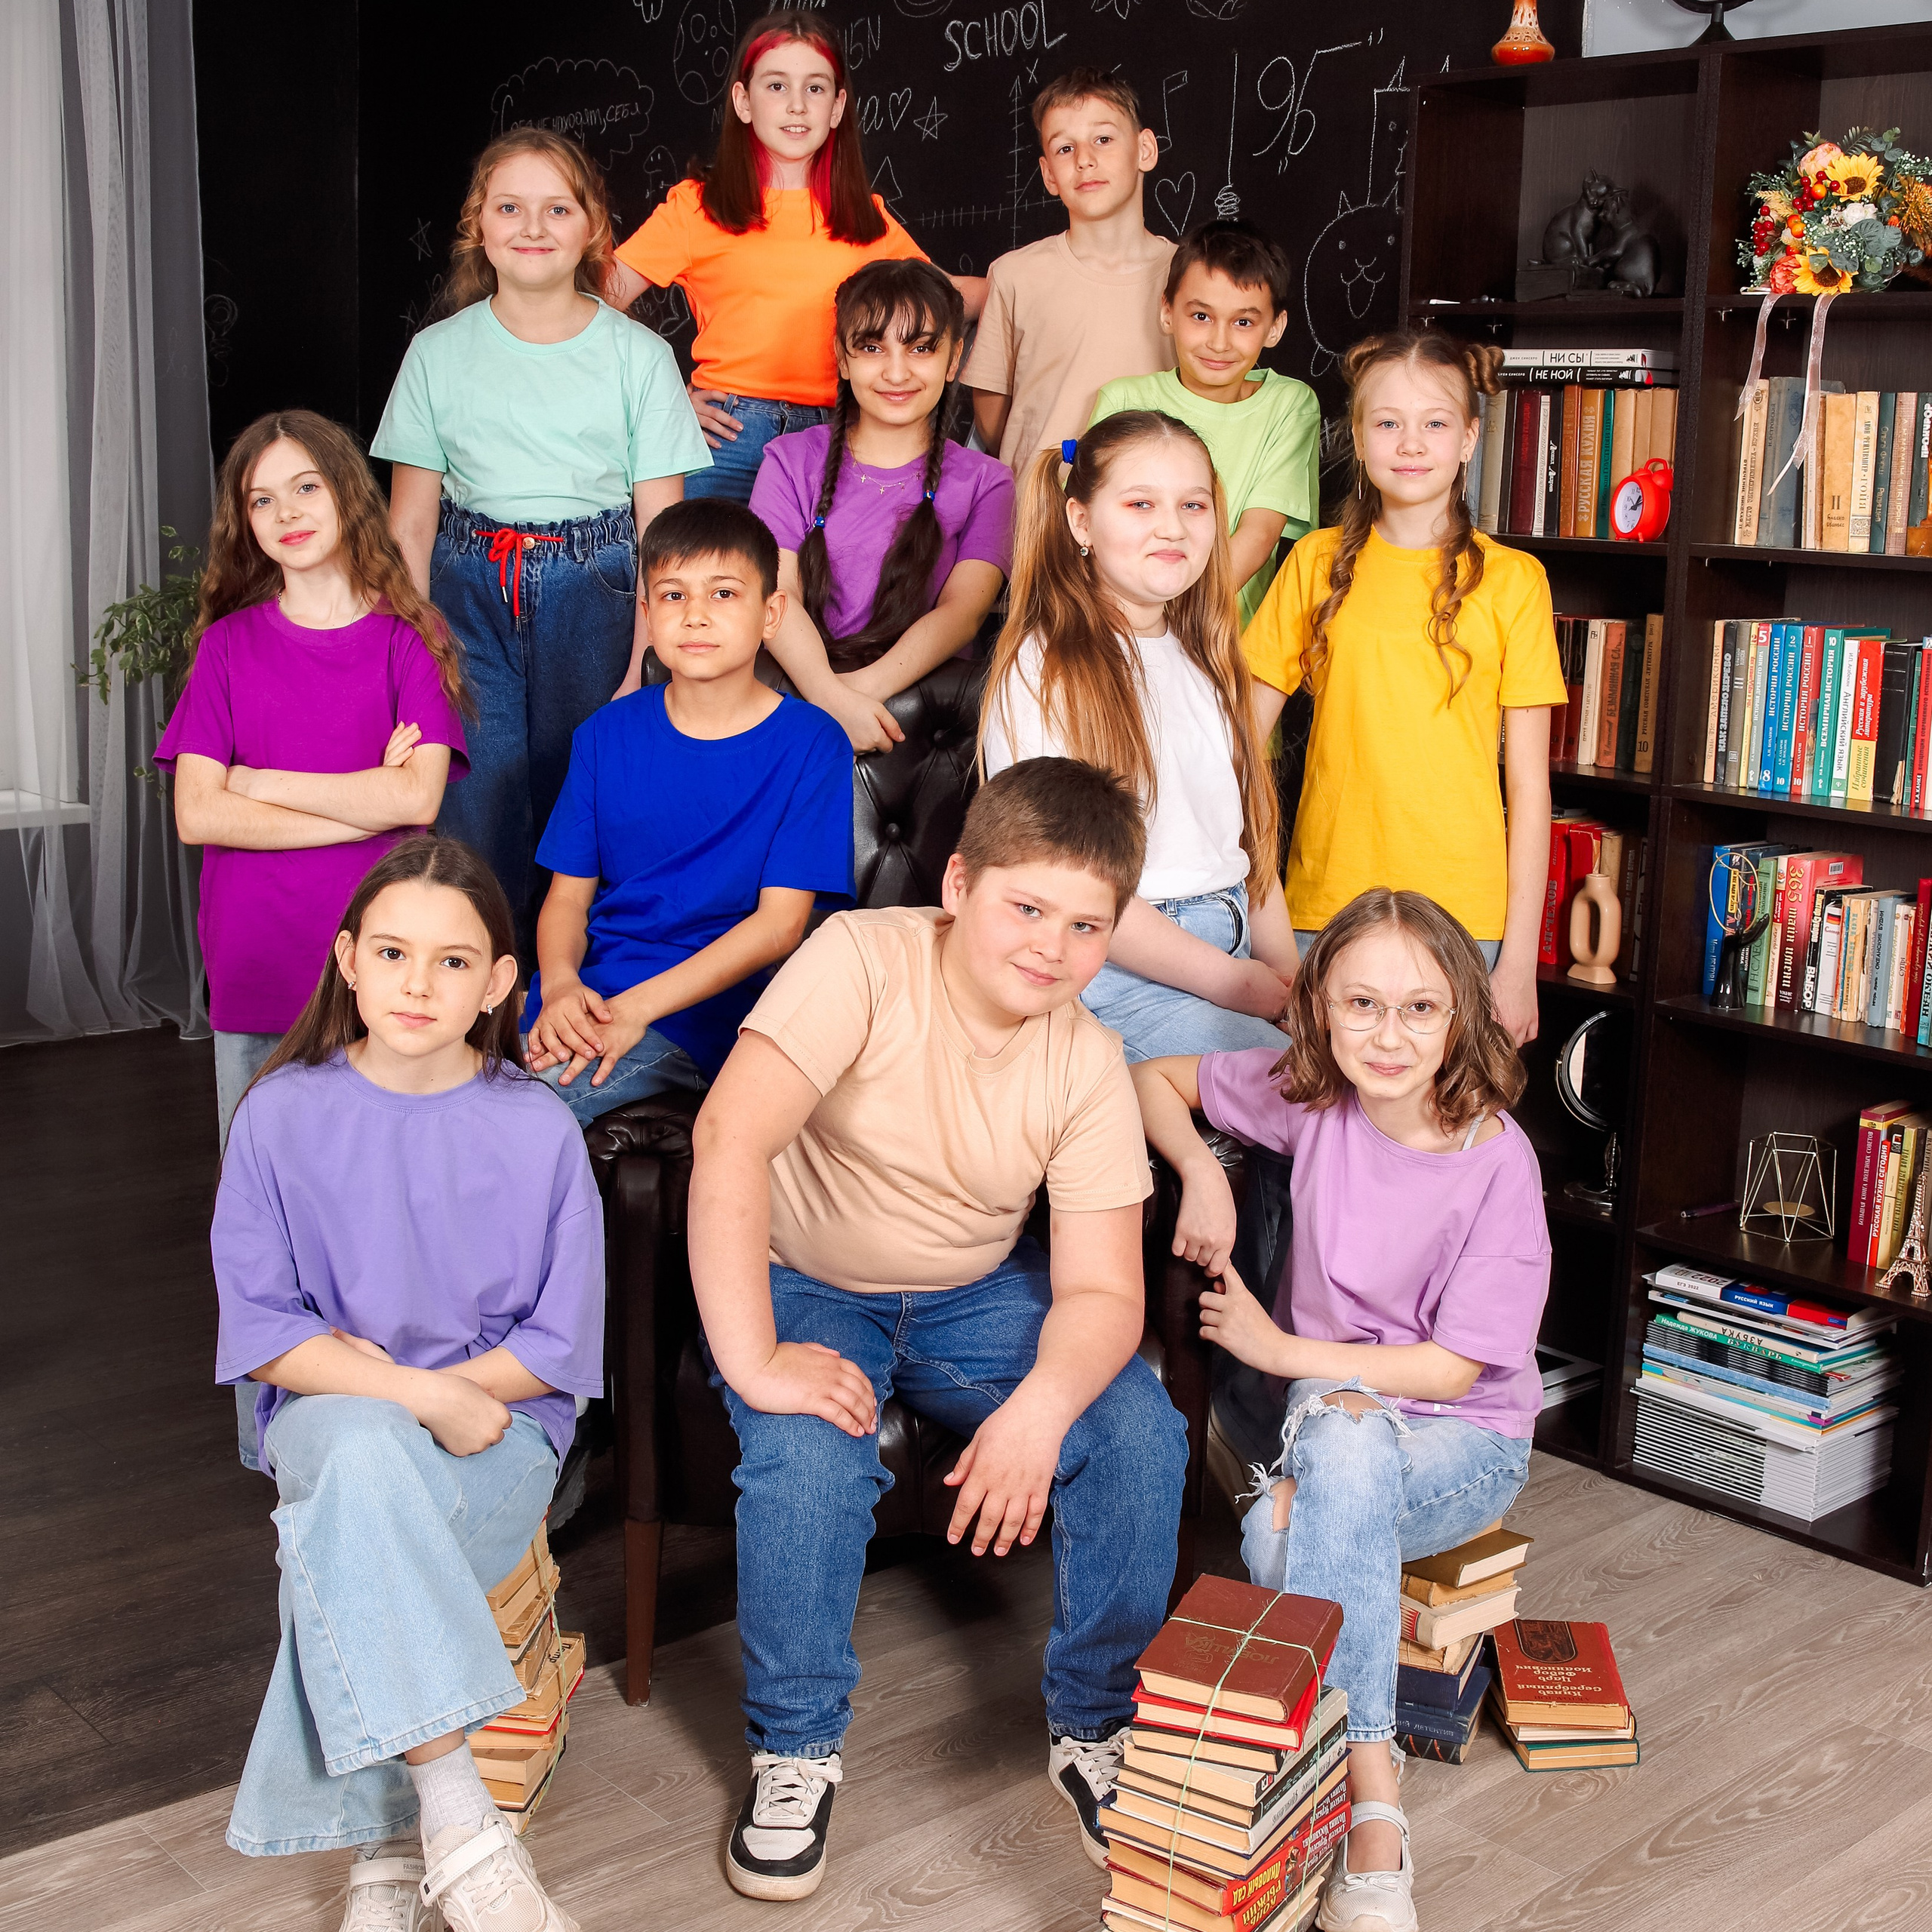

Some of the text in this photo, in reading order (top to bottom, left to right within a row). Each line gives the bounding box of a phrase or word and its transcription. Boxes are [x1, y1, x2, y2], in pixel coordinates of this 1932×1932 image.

[943, 0, 1067, 72] SCHOOL
[1535, 370, 1548, 380] НЕ
[1550, 368, 1574, 380] НОЙ
[1549, 353, 1565, 363] НИ
[1567, 352, 1584, 363] СЫ
[1577, 415, 1595, 513] РУССКАЯ КУХНЯ
[1858, 478, 1868, 509] ГОЙЯ
[1751, 634, 1757, 643] 2
[1758, 631, 1767, 643] 5
[1771, 637, 1780, 672] РОССИИ
[1790, 635, 1796, 644] 2
[1807, 635, 1812, 644] 1
[1829, 636, 1837, 647] 10
[1802, 652, 1812, 688] РОССИИ
[1825, 649, 1835, 692] ИСТОРИЯ
[1858, 658, 1869, 700] зарубежная
[1606, 662, 1620, 717] БЕЗЫМЯННАЯ
[1718, 652, 1732, 752] КАК ЗАПЕЛО ДЕРЕВО
[1768, 675, 1778, 716] ИСТОРИЯ
[1781, 651, 1795, 731] ИСТОРИЯ РОССИИ
[1798, 690, 1808, 732] ИСТОРИЯ
[1820, 693, 1832, 747] ВСЕМИРНАЯ
[1838, 691, 1852, 747] Английский
[1855, 708, 1866, 736] Русская
[1864, 693, 1875, 738] литература
[1920, 697, 1928, 737] СОВРЕМЕННОГО
[1638, 741, 1648, 752] 10
[1836, 749, 1845, 771] язык
[1918, 738, 1926, 771] КОНЦЕПЦИИ
[1762, 768, 1770, 782] 8
[1776, 776, 1785, 786] 10
[1793, 777, 1802, 786] 10
[1851, 745, 1863, 791] Избранные
[1860, 746, 1870, 789] сочинения
[1786, 865, 1804, 903] 365
[1786, 906, 1798, 943] тайн
[1810, 893, 1824, 943] Виктор Суворов
[1781, 946, 1794, 988] имени
[1875, 933, 1883, 970] ОКЕАНСКИЕ
[1802, 965, 1817, 1008] ВЫБОР
[1922, 973, 1932, 1017] ОКЕАН
[1857, 1131, 1874, 1226] БОЛЬШАЯ КНИГА ПОЛЕЗНЫХ СОВЕТОВ
[1872, 1144, 1889, 1238] РУССКАЯ КУХНЯ СЕГОДНЯ
[1690, 1272, 1729, 1286] 2022
[1734, 1294, 1774, 1309] РУССКИЙ ЯЗЫК
[1661, 1317, 1718, 1340] Надежда ЖУКОВА
[1721, 1327, 1763, 1346] АЗБУКА
[1727, 1338, 1783, 1360] БУКВАРЬ
[1517, 1684, 1602, 1692] Серебряный
[1538, 1675, 1572, 1683] Царь
[1328, 1811, 1346, 1831] Полина
[1328, 1822, 1346, 1840] Алексей
[403, 1863, 425, 1872] FASHION
[427, 1869, 445, 1886] FASHION
[1242, 1879, 1282, 1926] РЫЖИЙ
